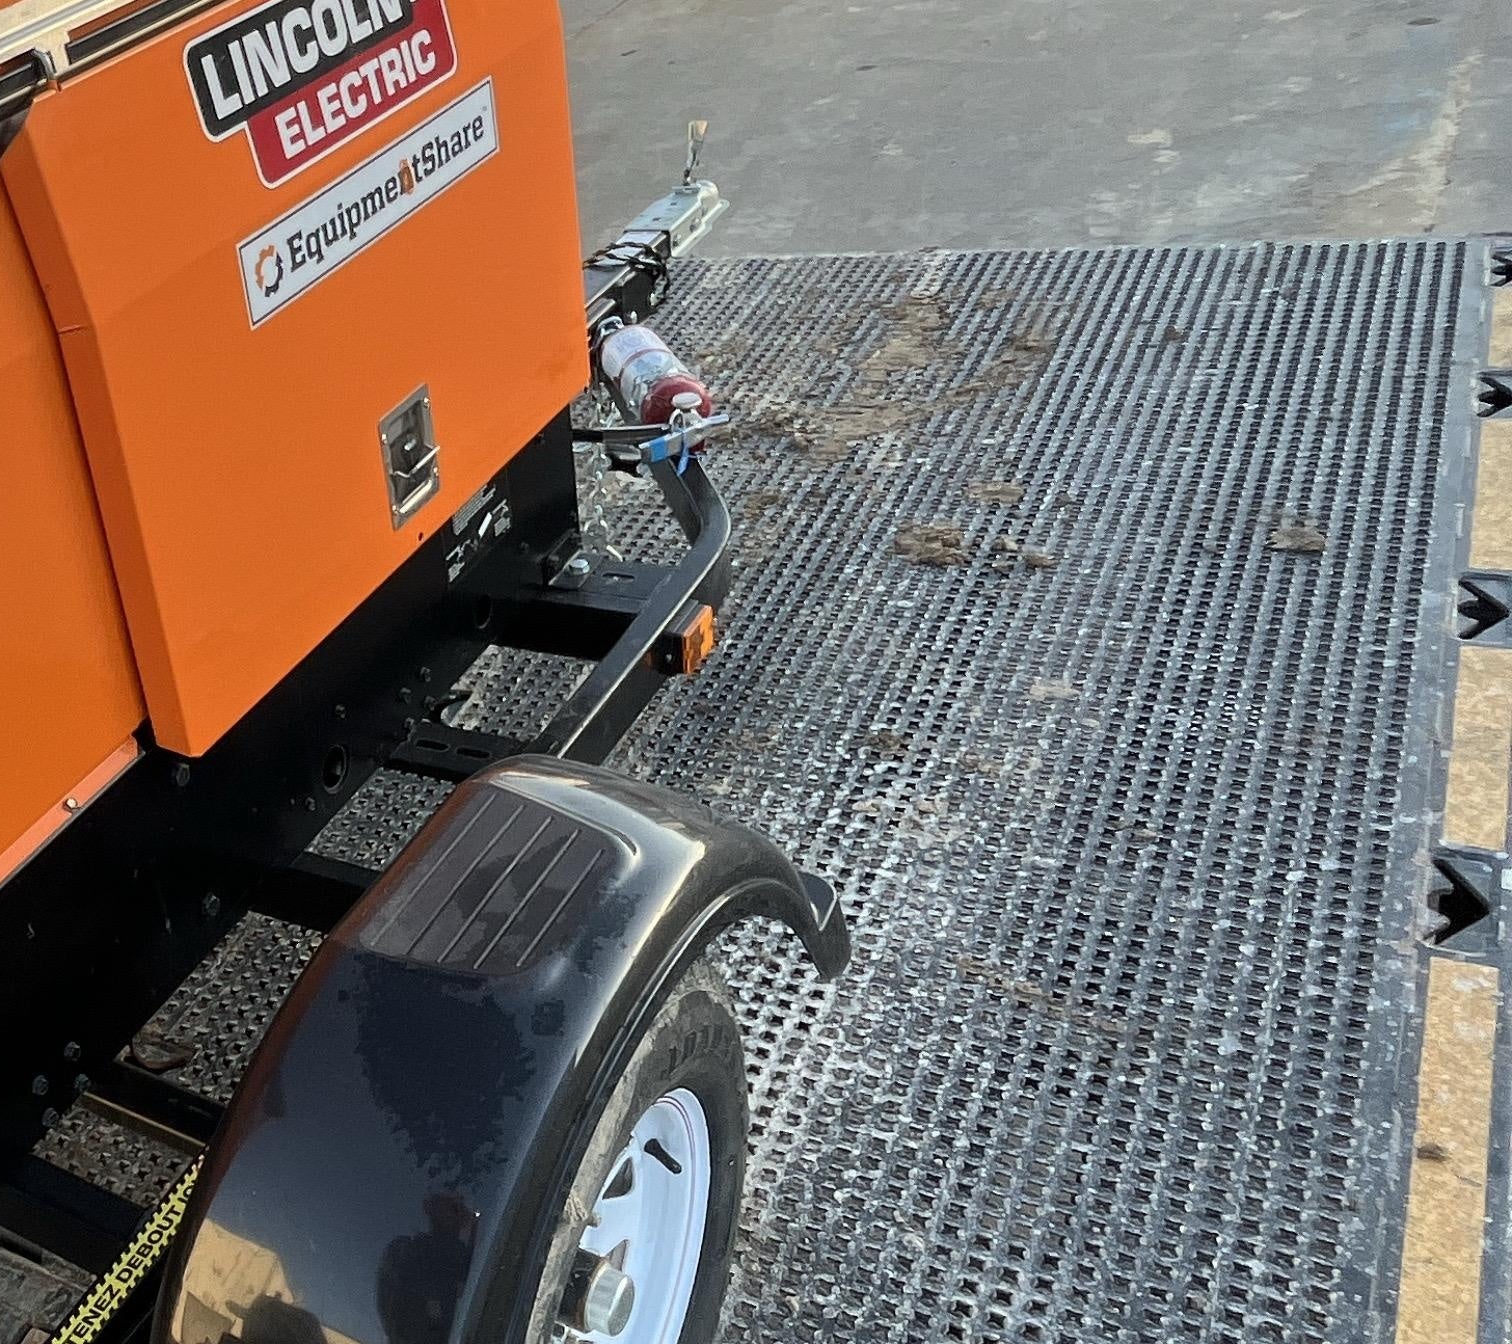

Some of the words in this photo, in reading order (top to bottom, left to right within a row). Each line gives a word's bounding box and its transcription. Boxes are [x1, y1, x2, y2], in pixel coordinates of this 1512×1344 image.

[274, 28, 437, 160] ELECTRIC
[286, 114, 485, 273] EquipmentShare
[115, 1204, 183, 1284] DEBOUT
